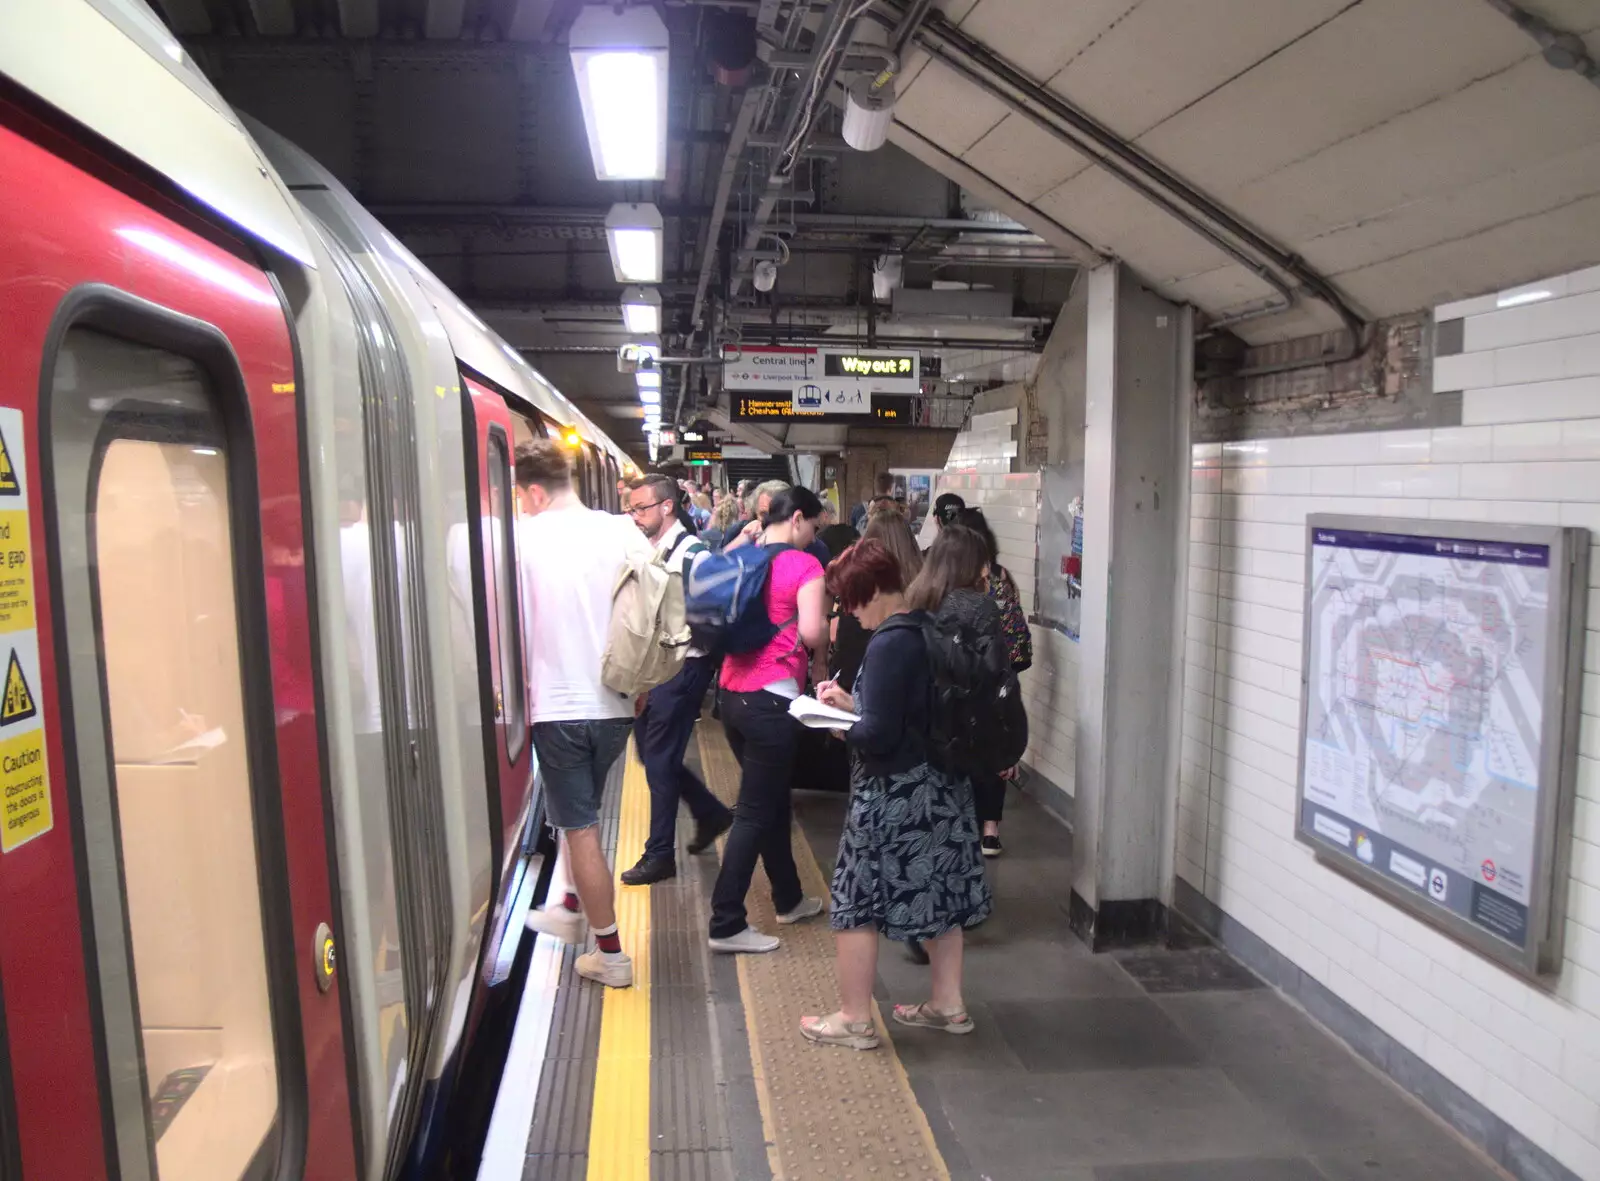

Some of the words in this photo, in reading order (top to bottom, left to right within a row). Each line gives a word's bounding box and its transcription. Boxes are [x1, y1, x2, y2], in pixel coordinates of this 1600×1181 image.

[752, 356, 786, 365] Central
[789, 356, 806, 365] line
[842, 356, 872, 375] Way
[872, 359, 897, 373] out
[762, 374, 793, 382] Liverpool
[748, 407, 780, 415] Chesham
[8, 550, 25, 569] gap
[3, 749, 41, 774] Caution
[5, 775, 42, 798] Obstructing
[6, 801, 18, 814] the
[19, 793, 37, 808] doors
[8, 808, 40, 830] dangerous
